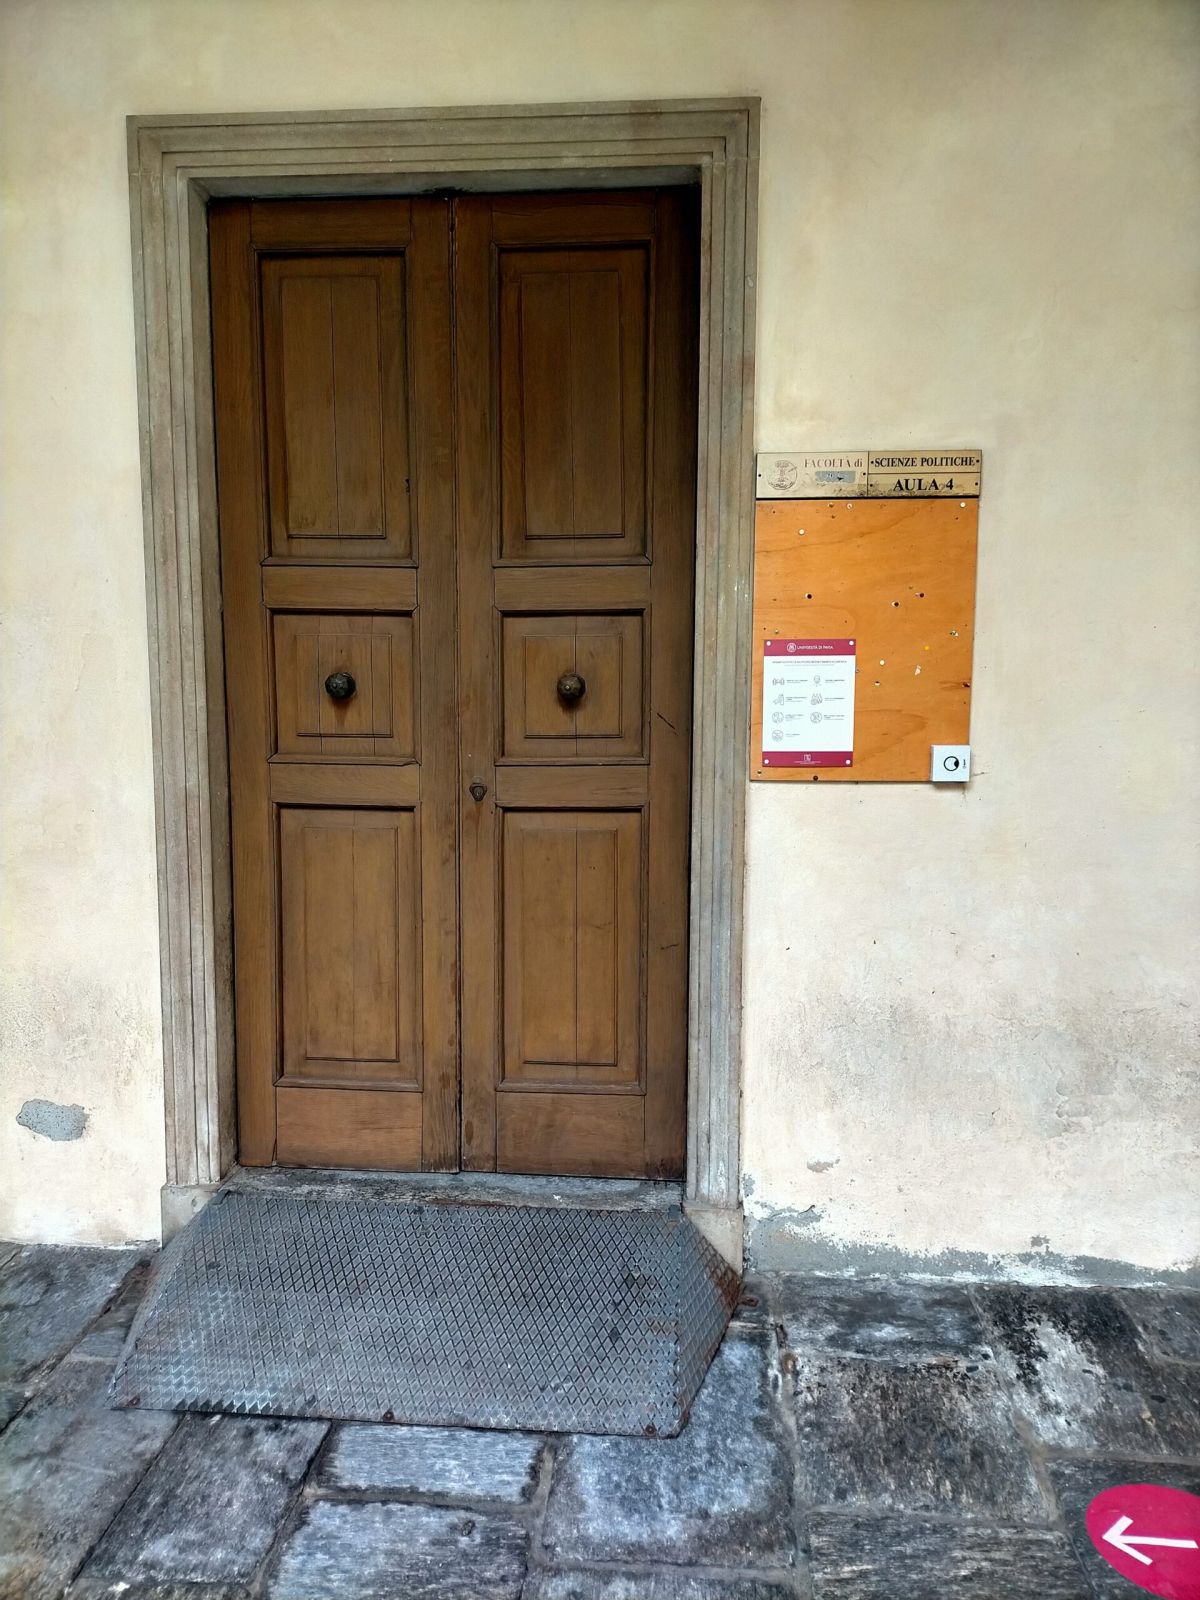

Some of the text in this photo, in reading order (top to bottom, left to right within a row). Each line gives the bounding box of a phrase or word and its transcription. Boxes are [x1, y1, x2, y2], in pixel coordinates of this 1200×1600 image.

[854, 458, 863, 468] di
[874, 456, 975, 467] SCIENZE POLITICHE
[893, 478, 954, 491] AULA 4
